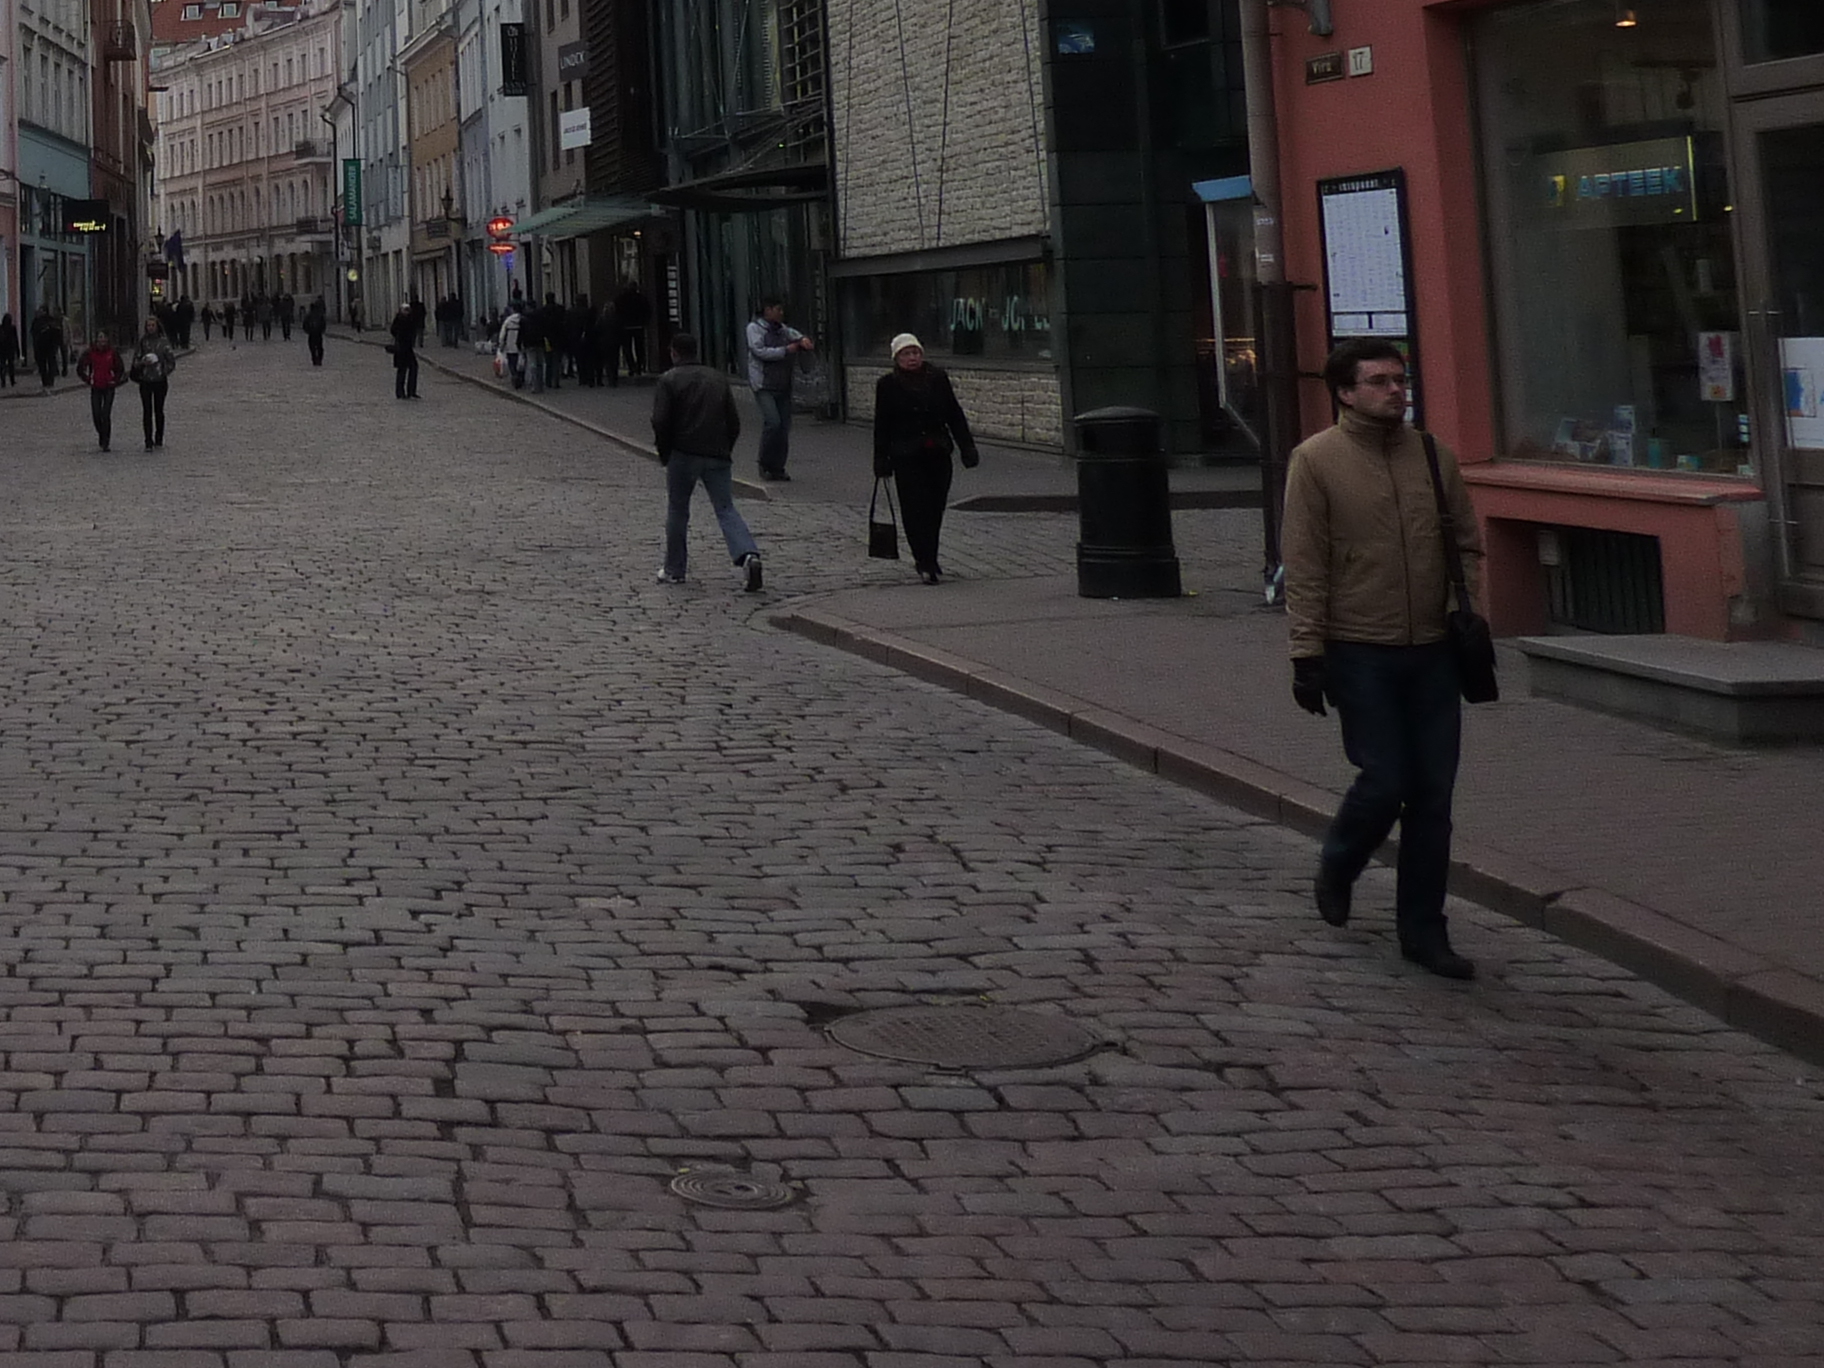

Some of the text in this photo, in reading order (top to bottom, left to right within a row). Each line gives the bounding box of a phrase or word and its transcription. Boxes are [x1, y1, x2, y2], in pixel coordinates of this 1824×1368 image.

[1353, 51, 1364, 71] 17
[1579, 165, 1684, 198] APTEEK
[950, 297, 986, 331] JACK
